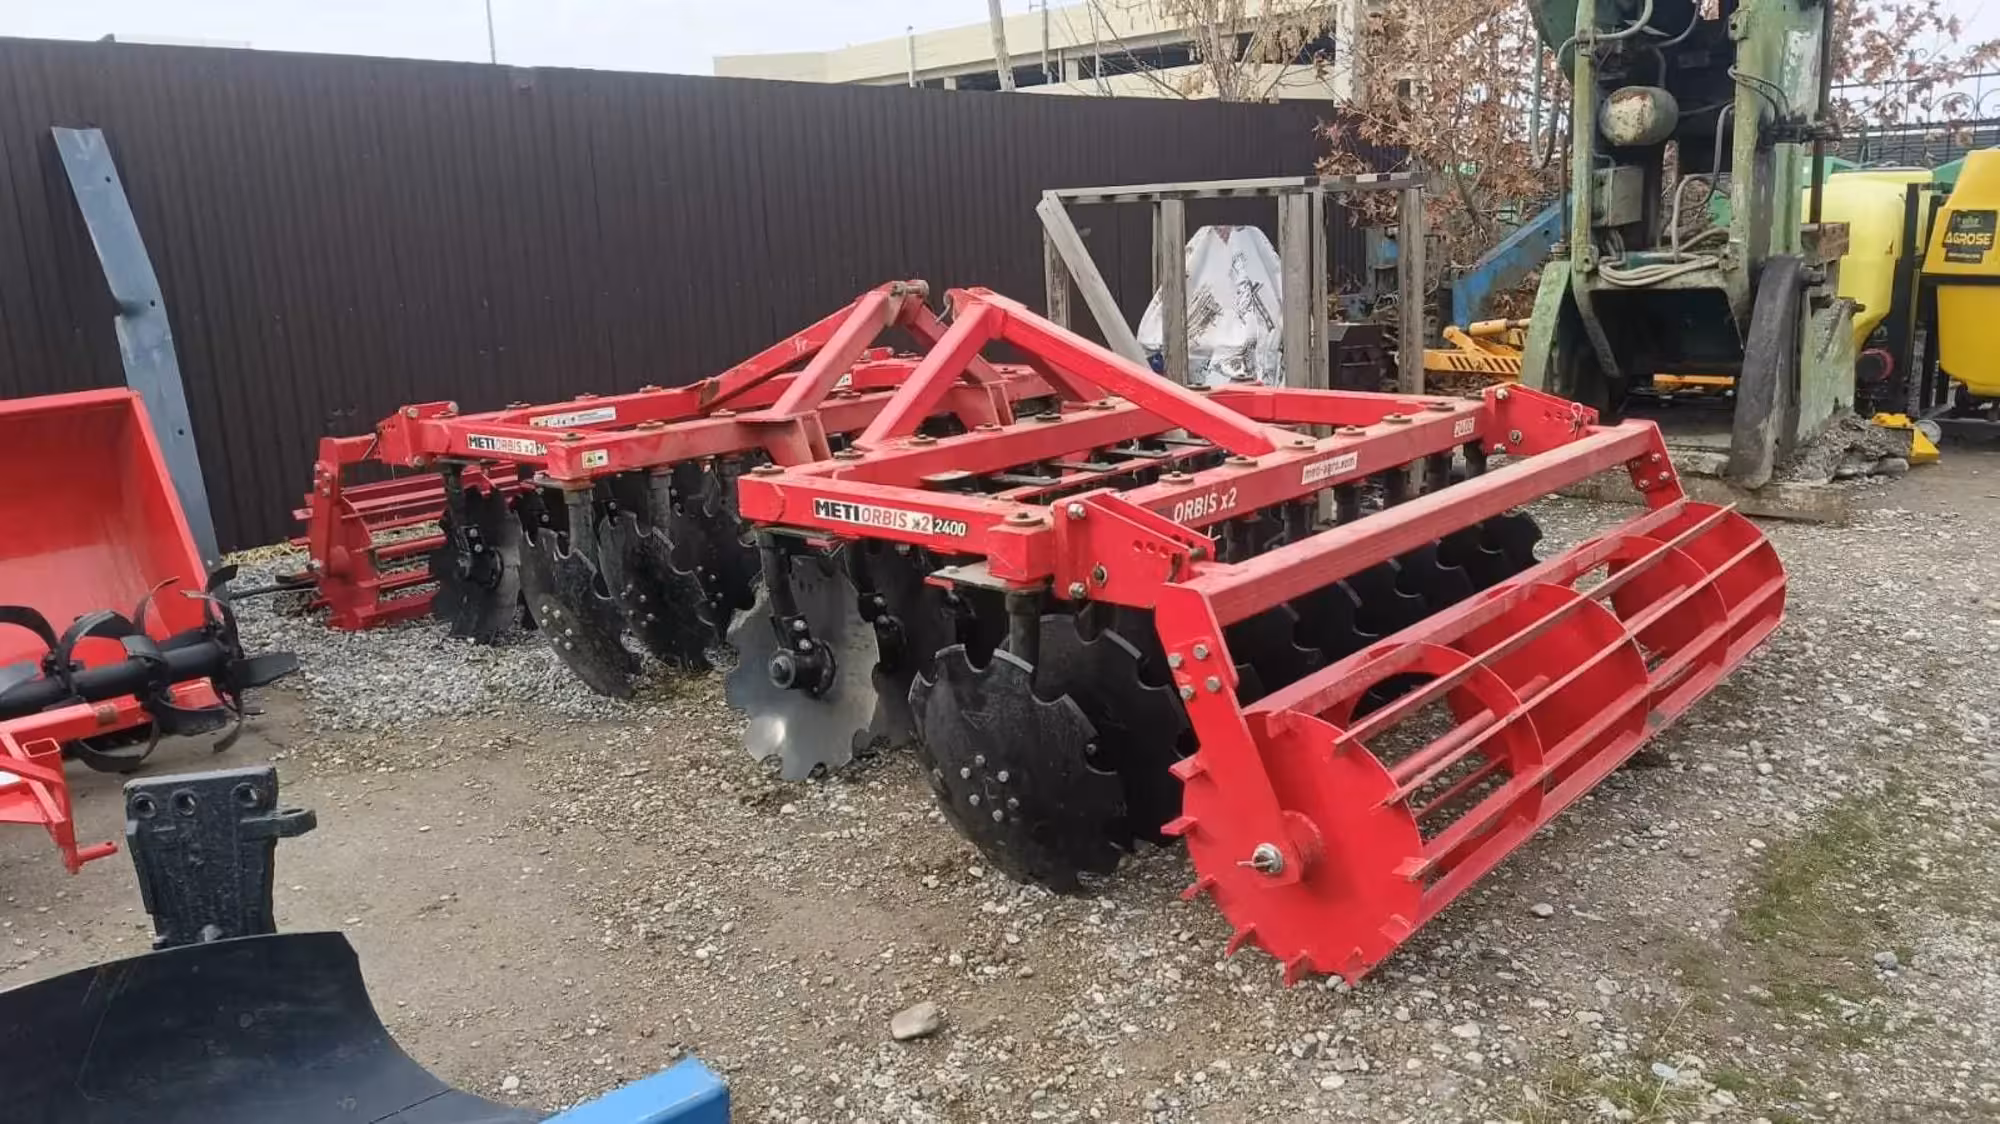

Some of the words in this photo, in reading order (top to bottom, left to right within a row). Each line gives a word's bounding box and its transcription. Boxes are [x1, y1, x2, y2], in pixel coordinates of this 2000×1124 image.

[1944, 231, 1992, 246] AGROSE
[815, 499, 859, 521] METI
[861, 507, 908, 529] ORBIS
[912, 515, 930, 531] x2
[934, 519, 967, 536] 2400
[1174, 492, 1218, 523] ORBIS
[1220, 487, 1237, 511] x2
